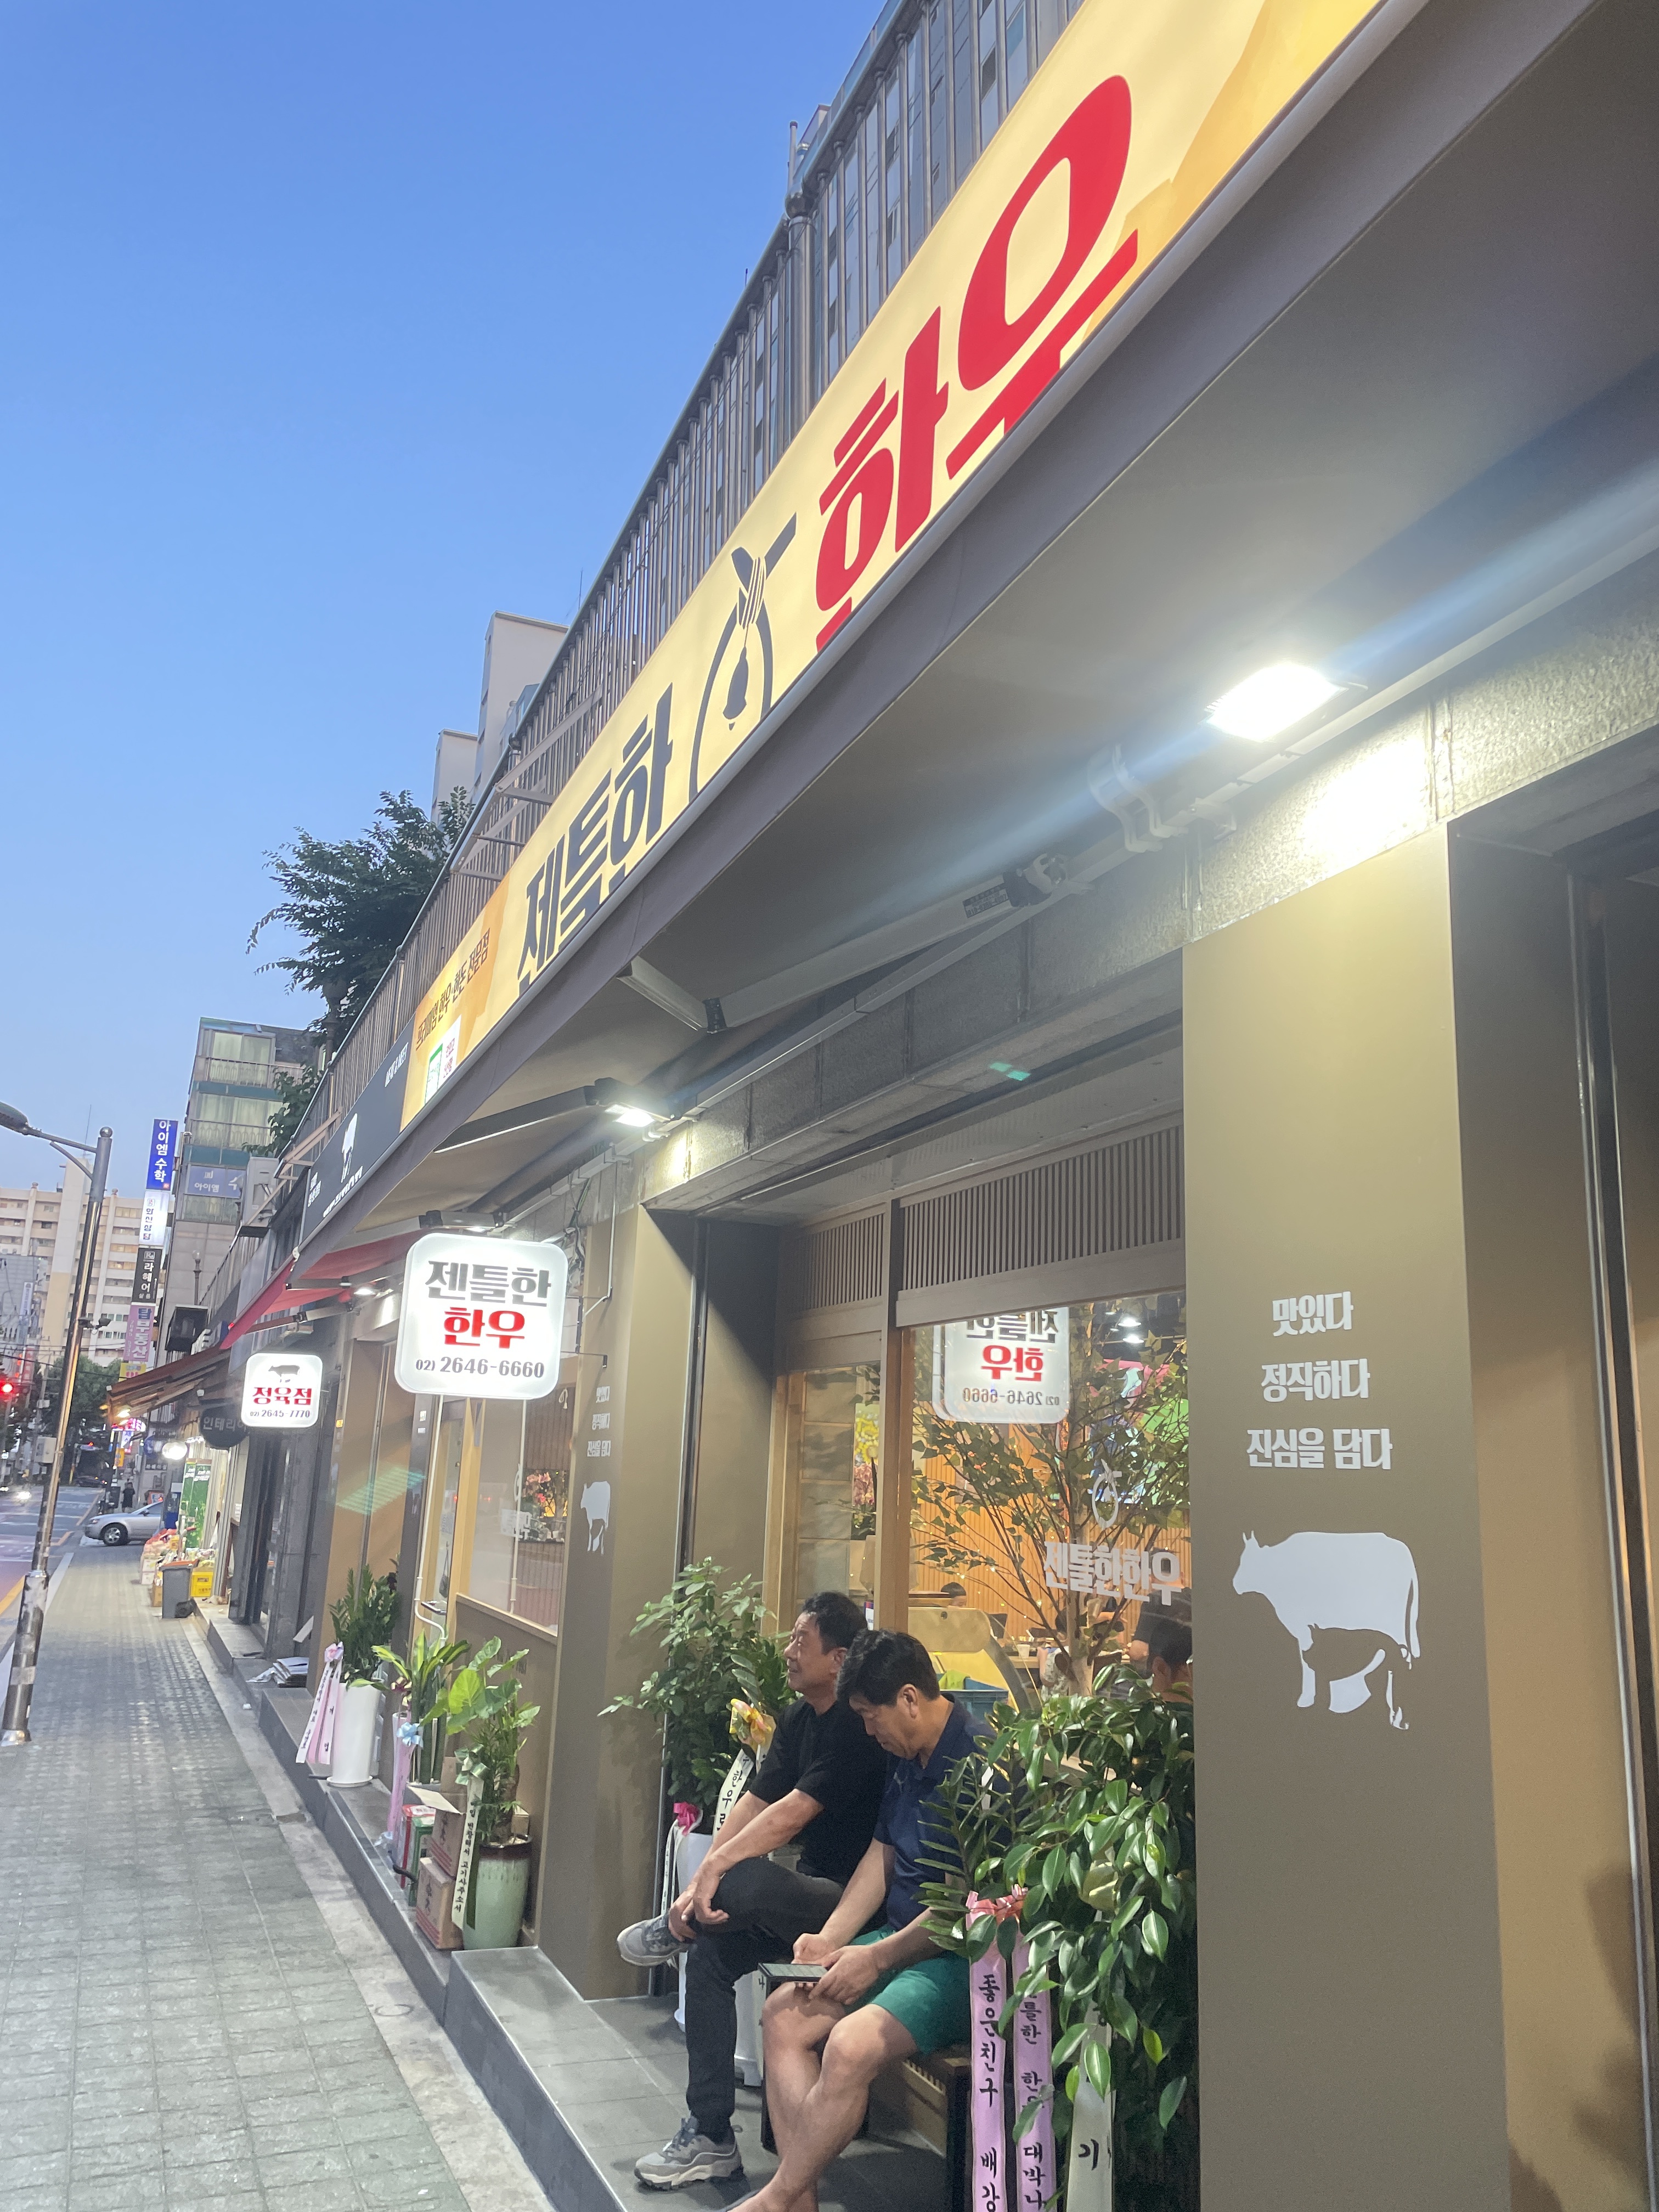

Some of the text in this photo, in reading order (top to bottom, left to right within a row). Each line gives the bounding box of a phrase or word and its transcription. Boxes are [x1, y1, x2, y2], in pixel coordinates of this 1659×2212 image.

[517, 75, 1139, 997] 젠틀한 한우
[466, 927, 490, 985] 전문점
[194, 1182, 219, 1193] 아이엠
[425, 1260, 551, 1307] 젠틀한
[444, 1307, 525, 1349] 한우
[1272, 1291, 1354, 1337] 맛있다
[415, 1356, 545, 1378] 02) 2646-6660
[1261, 1358, 1371, 1403] 정직하다
[252, 1387, 312, 1406] 정육점
[261, 1409, 311, 1418] 2645-7770
[1246, 1428, 1393, 1470] 진심을 담다
[1020, 1995, 1042, 2045] 틀한
